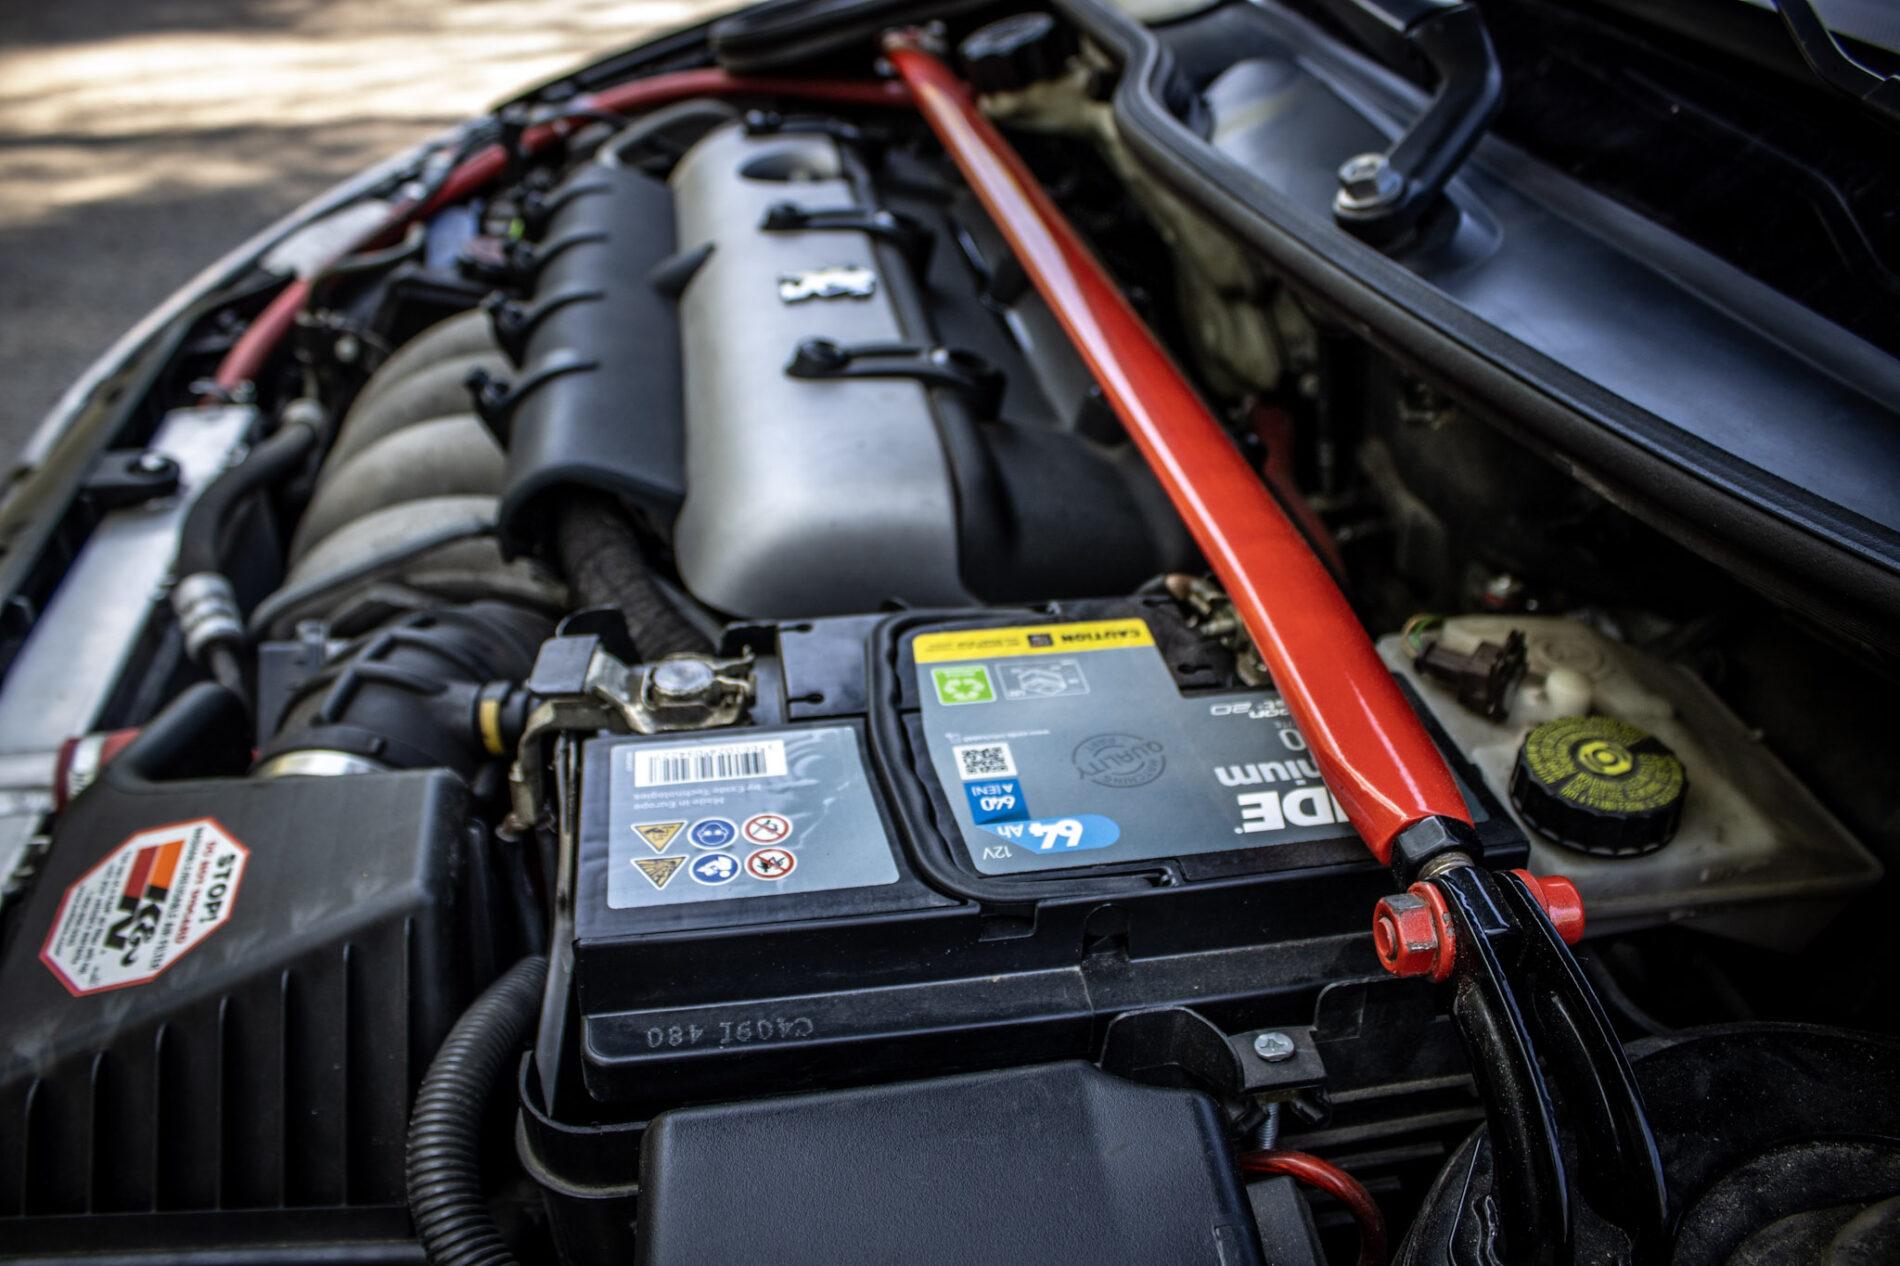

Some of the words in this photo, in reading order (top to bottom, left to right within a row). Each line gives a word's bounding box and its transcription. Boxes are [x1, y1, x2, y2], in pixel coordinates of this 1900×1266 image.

[1060, 628, 1141, 645] CAUTION
[1075, 740, 1164, 780] QUALITY
[1103, 757, 1160, 785] MATCHING
[633, 788, 711, 801] Technologies
[1001, 783, 1013, 795] A
[633, 800, 676, 811] Europe
[678, 799, 691, 808] in
[691, 797, 725, 808] Made
[980, 795, 1016, 812] 640
[1236, 786, 1349, 834] IDE
[997, 823, 1024, 839] Ah
[1028, 818, 1084, 850] 64
[982, 845, 1014, 861] 12V
[198, 853, 236, 924] STOP!
[646, 1023, 704, 1048] 480
